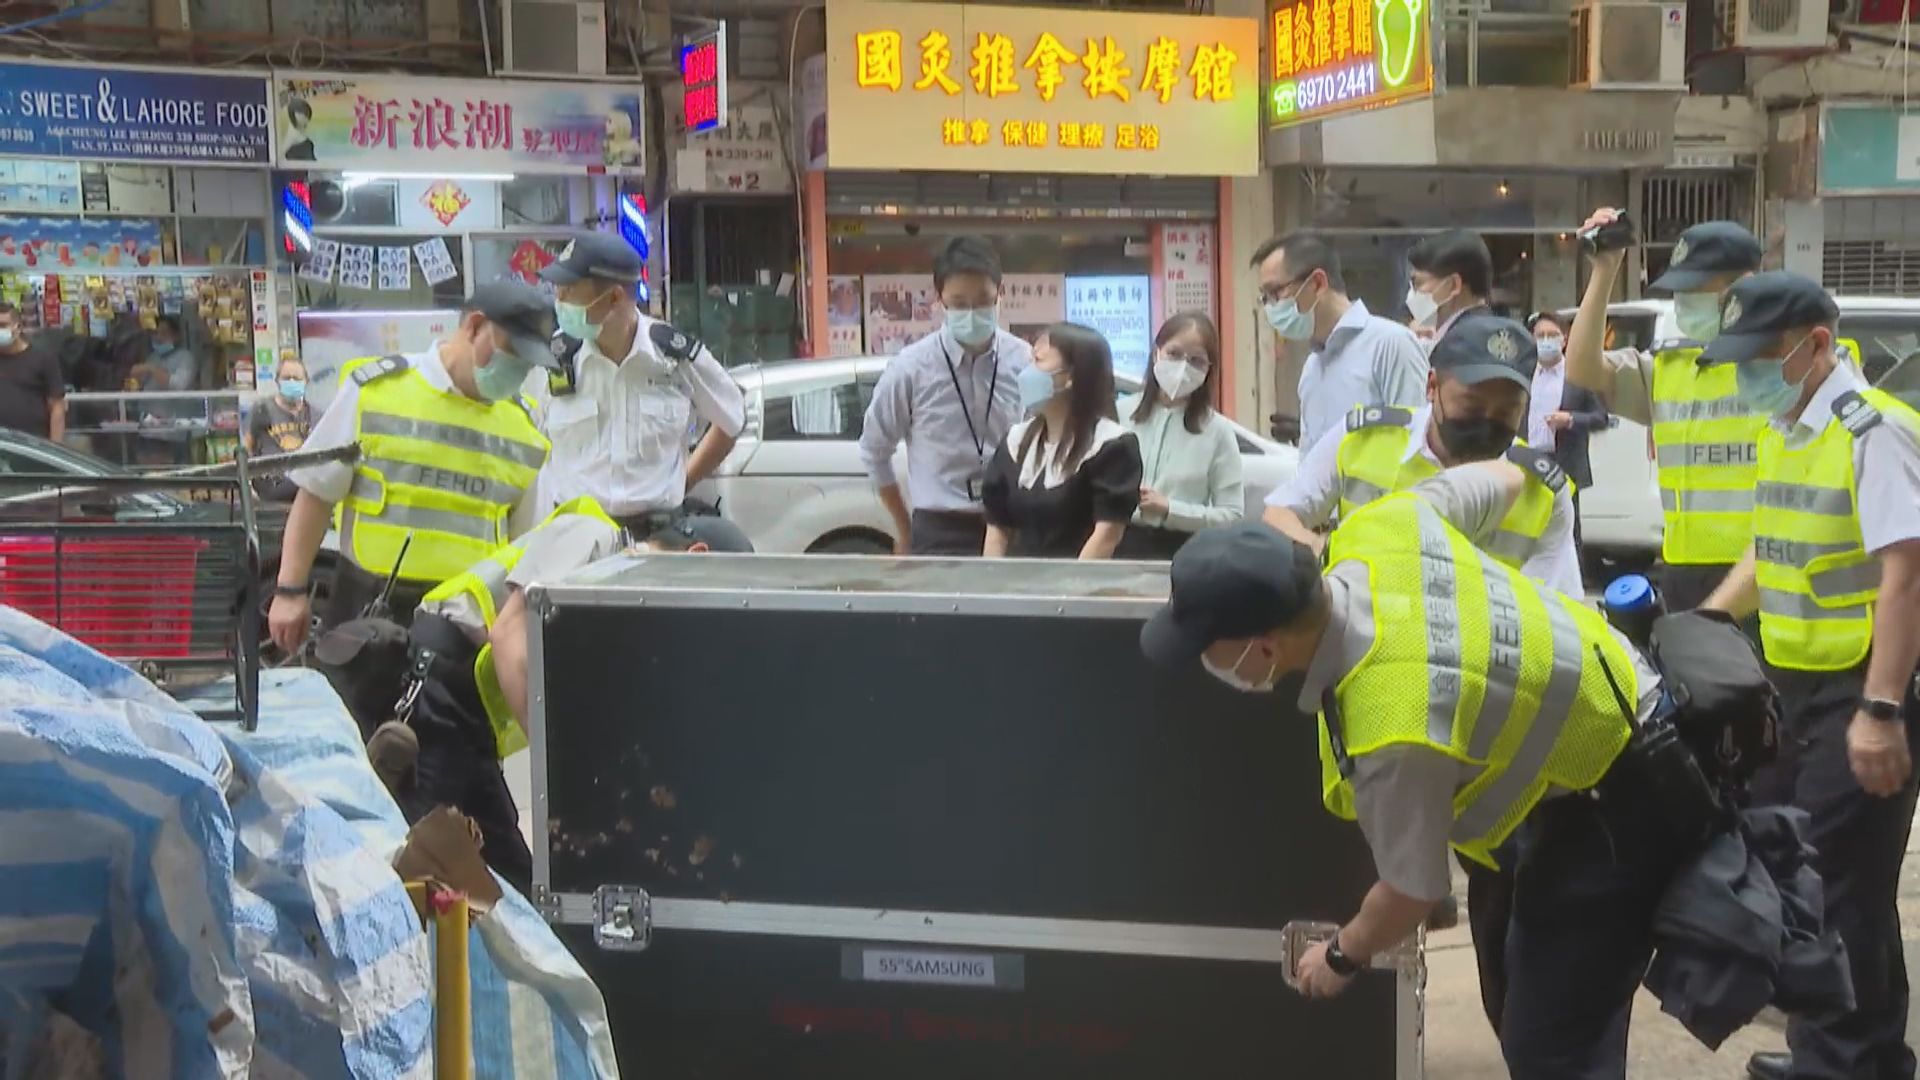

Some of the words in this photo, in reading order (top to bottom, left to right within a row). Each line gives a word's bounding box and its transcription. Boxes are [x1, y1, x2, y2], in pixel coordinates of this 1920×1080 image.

[853, 29, 1238, 104] 國灸推拿按摩館
[1297, 70, 1335, 110] 6970
[1337, 61, 1376, 98] 2441
[20, 90, 92, 120] SWEET
[97, 77, 119, 123] &
[122, 97, 206, 126] LAHORE
[216, 101, 268, 128] FOOD
[350, 95, 513, 151] 新浪潮
[943, 117, 991, 146] 推拿
[1002, 119, 1048, 148] 保健
[1058, 121, 1104, 149] 理療
[1115, 122, 1160, 151] 足浴
[418, 467, 486, 495] FEHD
